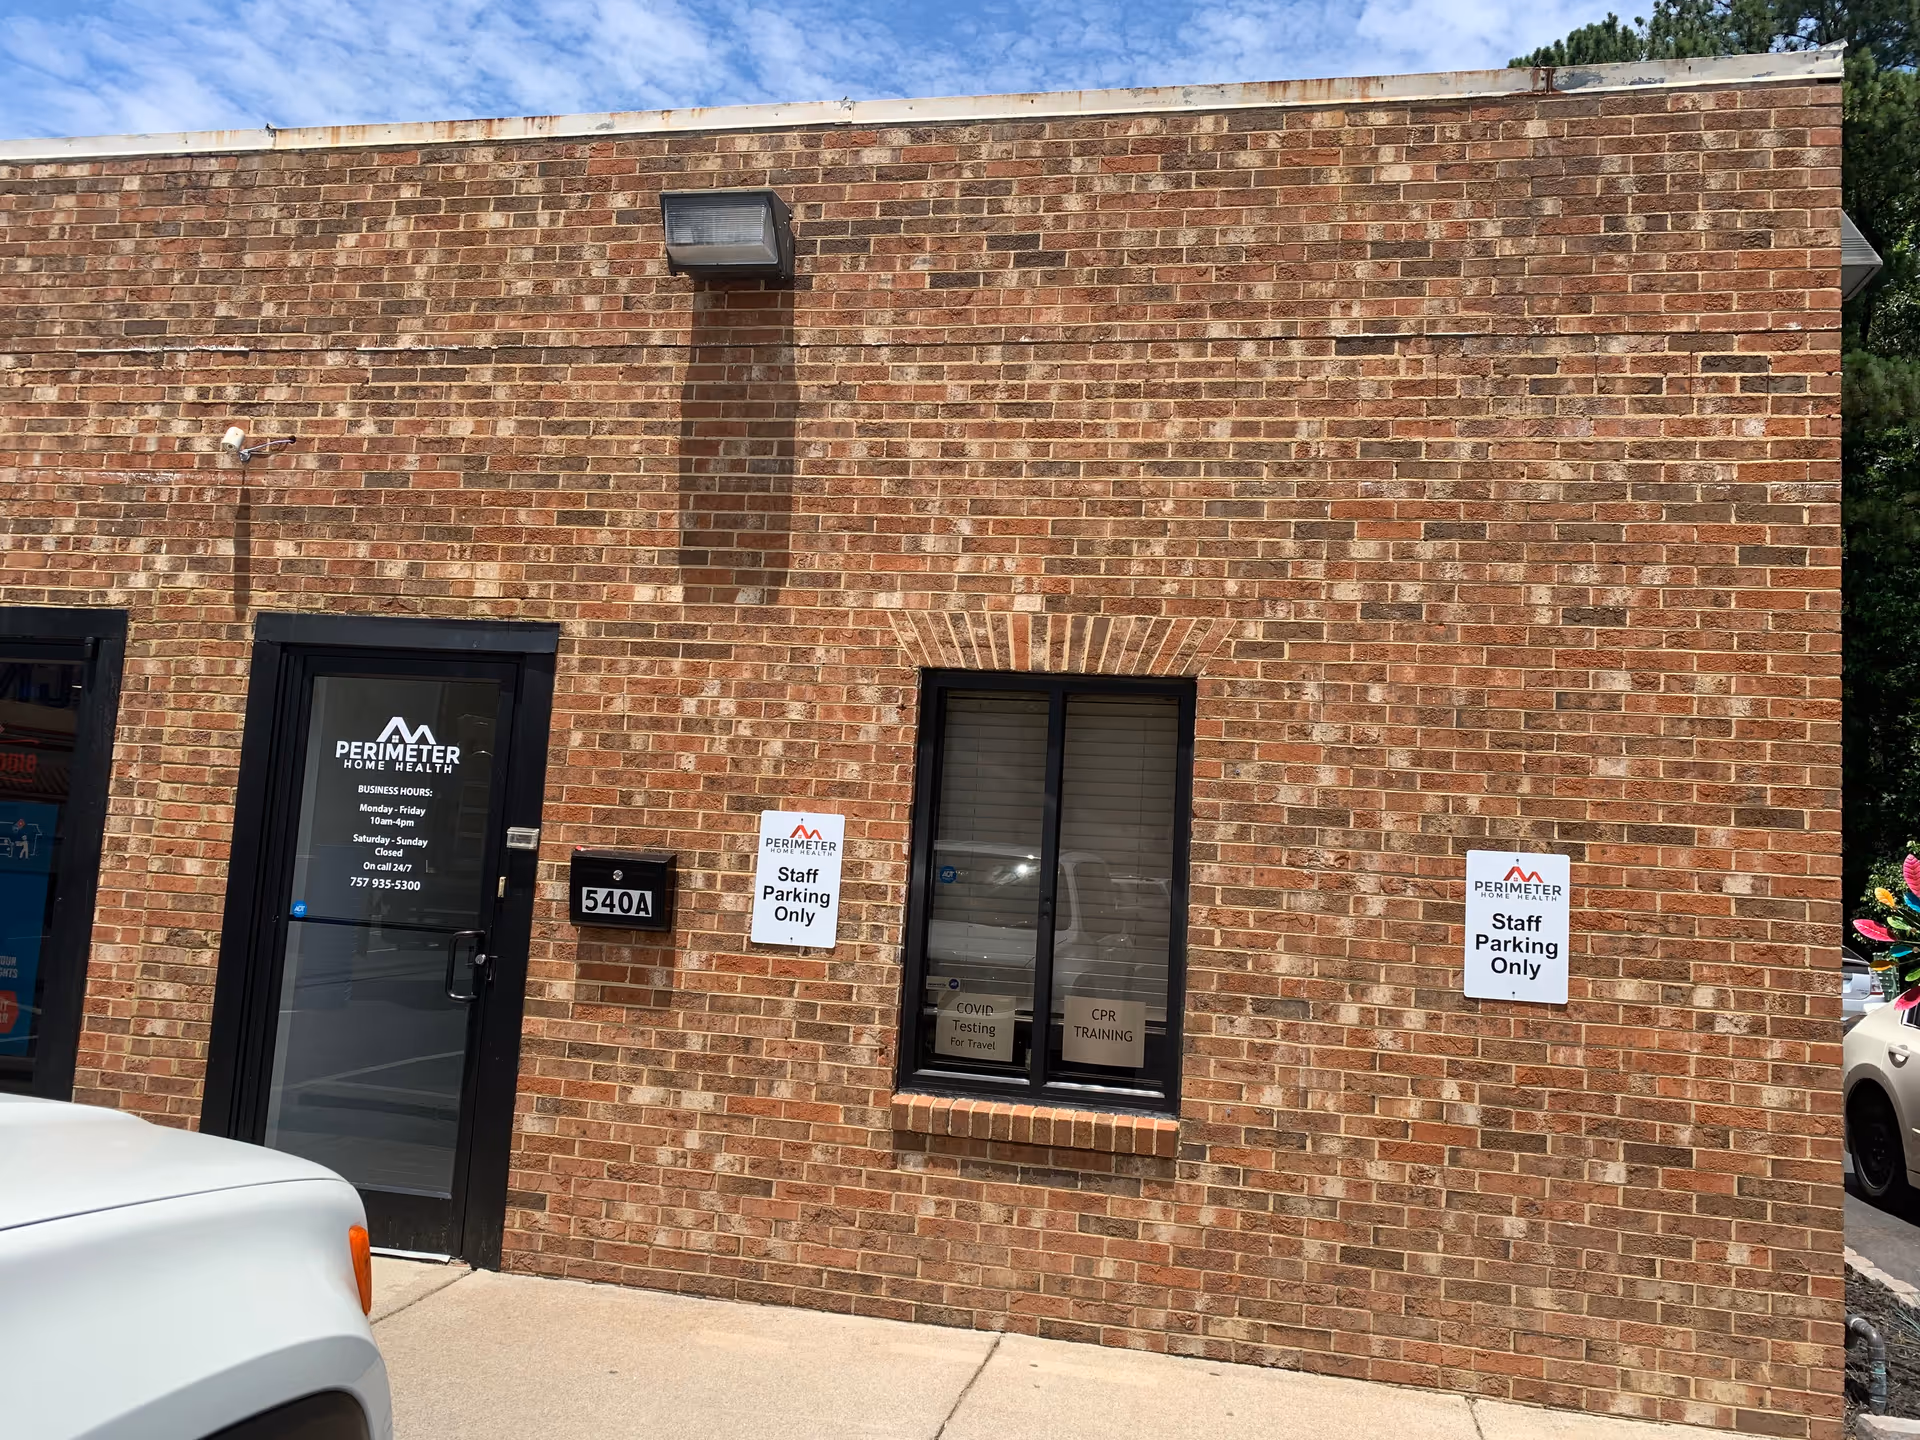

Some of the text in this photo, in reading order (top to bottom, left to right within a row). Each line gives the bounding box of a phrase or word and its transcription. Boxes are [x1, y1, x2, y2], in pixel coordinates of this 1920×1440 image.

[335, 741, 461, 764] PERIMETER
[343, 759, 453, 774] HOME HEALTH
[358, 785, 433, 797] BUSINESS HOURS:
[359, 803, 394, 814] Monday
[399, 805, 426, 816] Friday
[370, 816, 415, 828] 10am-4pm
[353, 834, 390, 845] Saturday
[396, 836, 428, 848] Sunday
[765, 837, 837, 852] PERIMETER
[375, 848, 403, 857] Closed
[799, 849, 833, 857] HEALTH
[363, 861, 412, 873] On call 24/7
[777, 866, 819, 884] Staff
[350, 876, 421, 890] 757 935-5300
[1474, 880, 1562, 896] PERIMETER
[584, 889, 651, 916] 540A
[762, 885, 831, 908] Parking
[1517, 893, 1557, 902] HEALTH
[774, 906, 815, 927] Only
[1492, 912, 1543, 932] Staff
[1475, 933, 1559, 959] Parking
[1491, 957, 1542, 981] Only
[956, 1002, 994, 1017] COVID
[1091, 1008, 1117, 1022] CPR
[953, 1019, 996, 1038] Testing
[1073, 1025, 1133, 1043] TRAINING
[950, 1036, 996, 1051] For Travel
